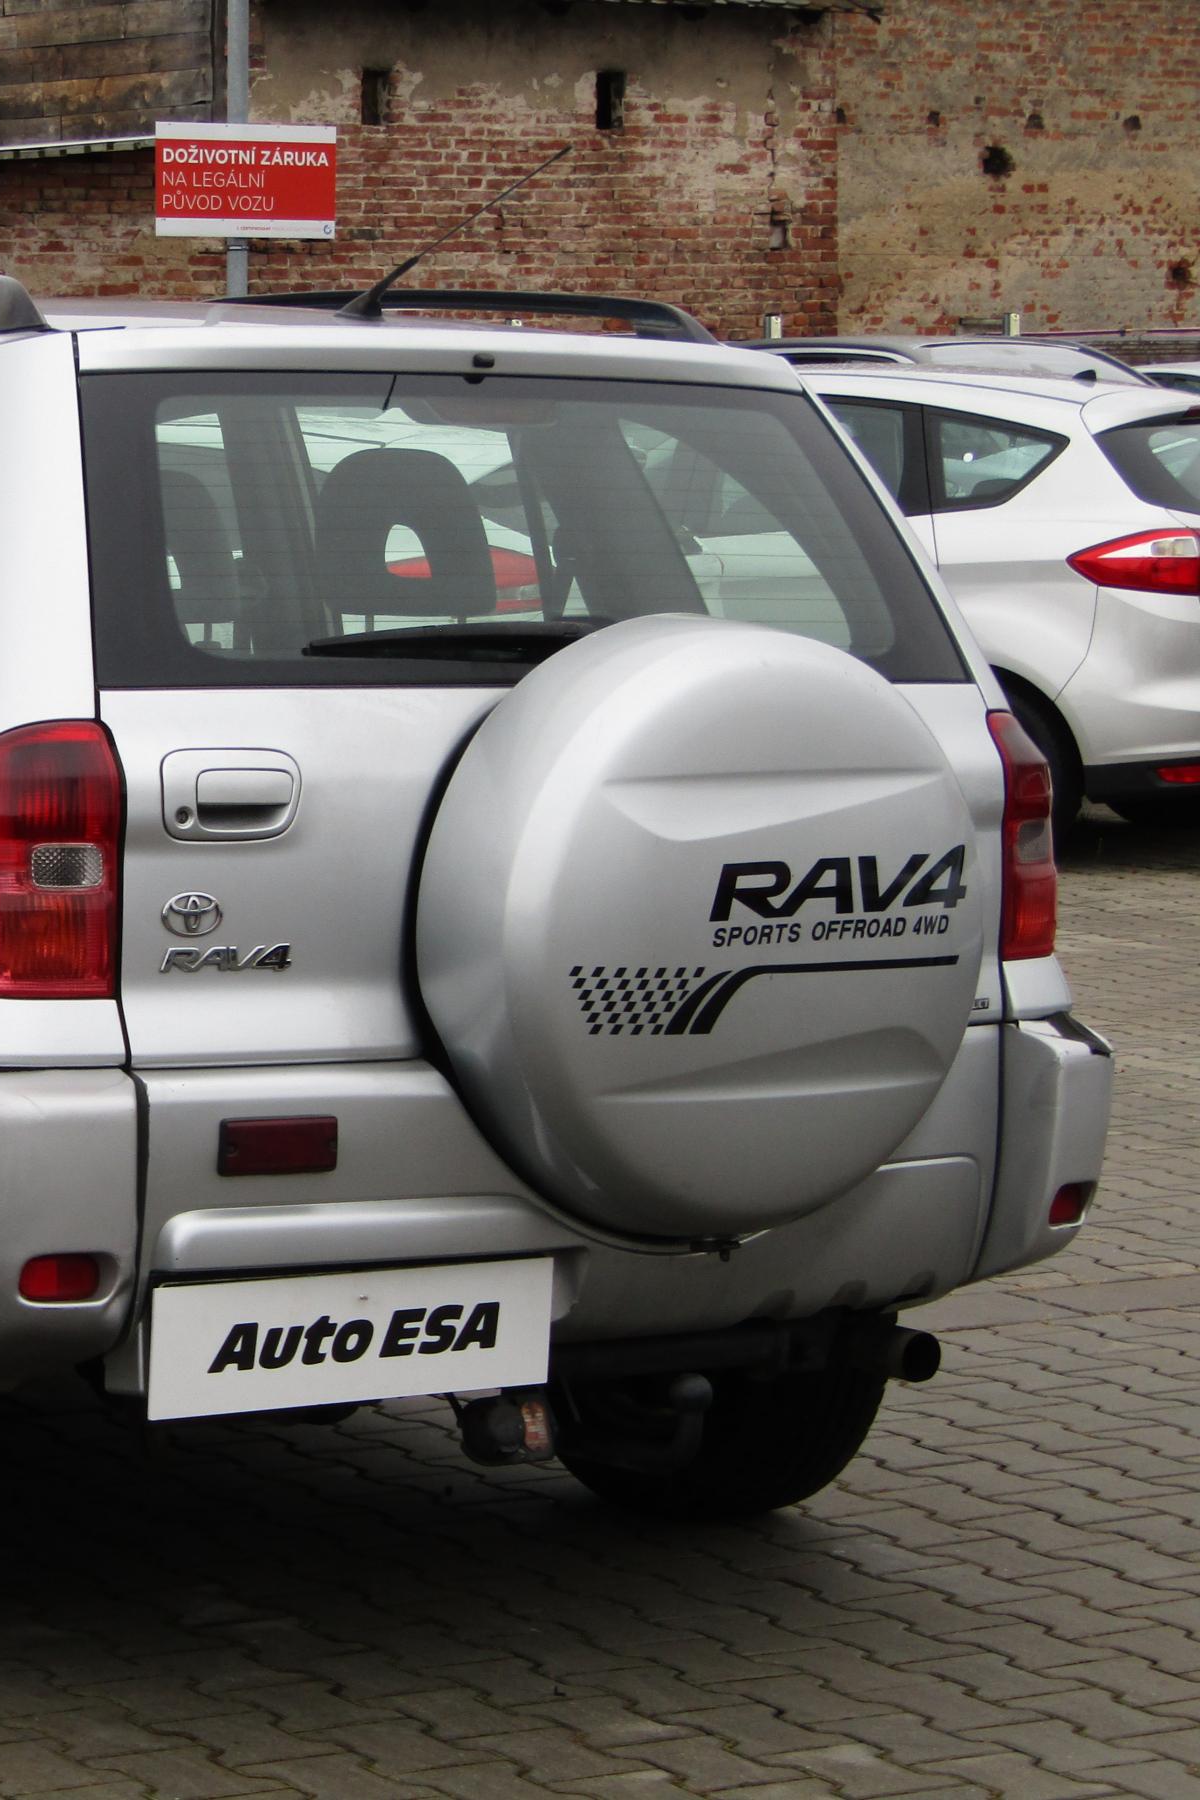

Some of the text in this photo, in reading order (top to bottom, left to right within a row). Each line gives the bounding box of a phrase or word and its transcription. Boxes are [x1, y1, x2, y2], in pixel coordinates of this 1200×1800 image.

[162, 144, 330, 167] DOŽIVOTNÍ ZÁRUKA
[162, 169, 265, 188] NA LEGÁLNÍ
[162, 190, 275, 212] PŮVOD VOZU
[708, 844, 968, 922] RAV4
[712, 914, 950, 948] SPORTS OFFROAD 4WD
[159, 943, 292, 974] RAV4
[207, 1301, 501, 1374] Auto ESA
